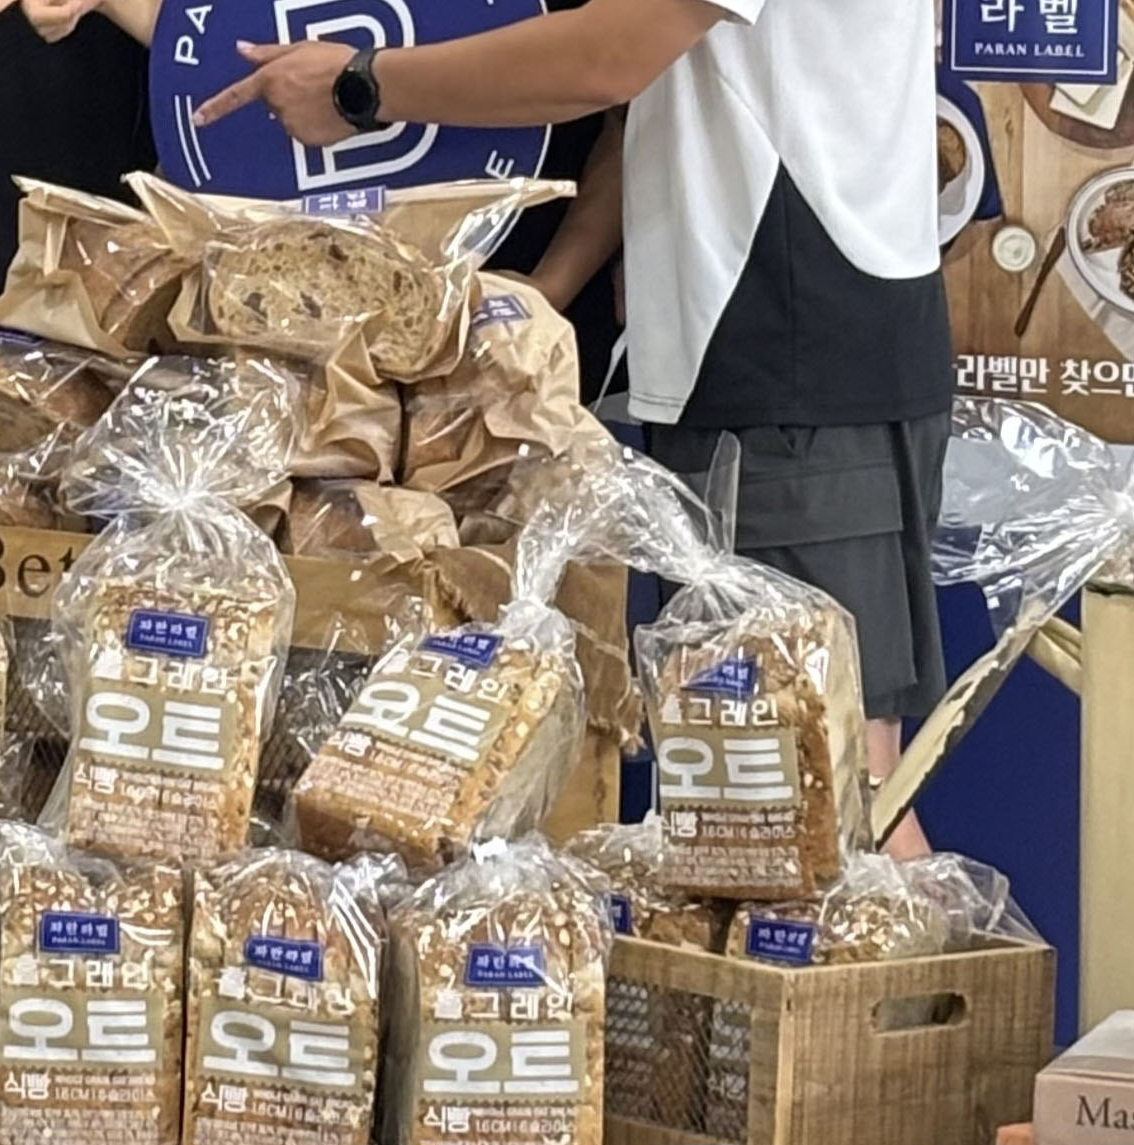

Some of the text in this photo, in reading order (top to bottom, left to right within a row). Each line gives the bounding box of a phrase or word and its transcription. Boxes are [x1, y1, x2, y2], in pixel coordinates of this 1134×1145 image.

[974, 42, 1085, 57] PARAN LABEL
[953, 355, 1050, 393] 라벨만
[79, 691, 224, 770] 오트
[339, 681, 490, 761] 오트
[658, 737, 793, 800] 오트
[4, 998, 156, 1063] 오트
[203, 1011, 356, 1085] 오트
[4, 1069, 51, 1101] 식빵
[423, 1031, 578, 1094] 오트
[424, 1107, 470, 1133] 식빵
